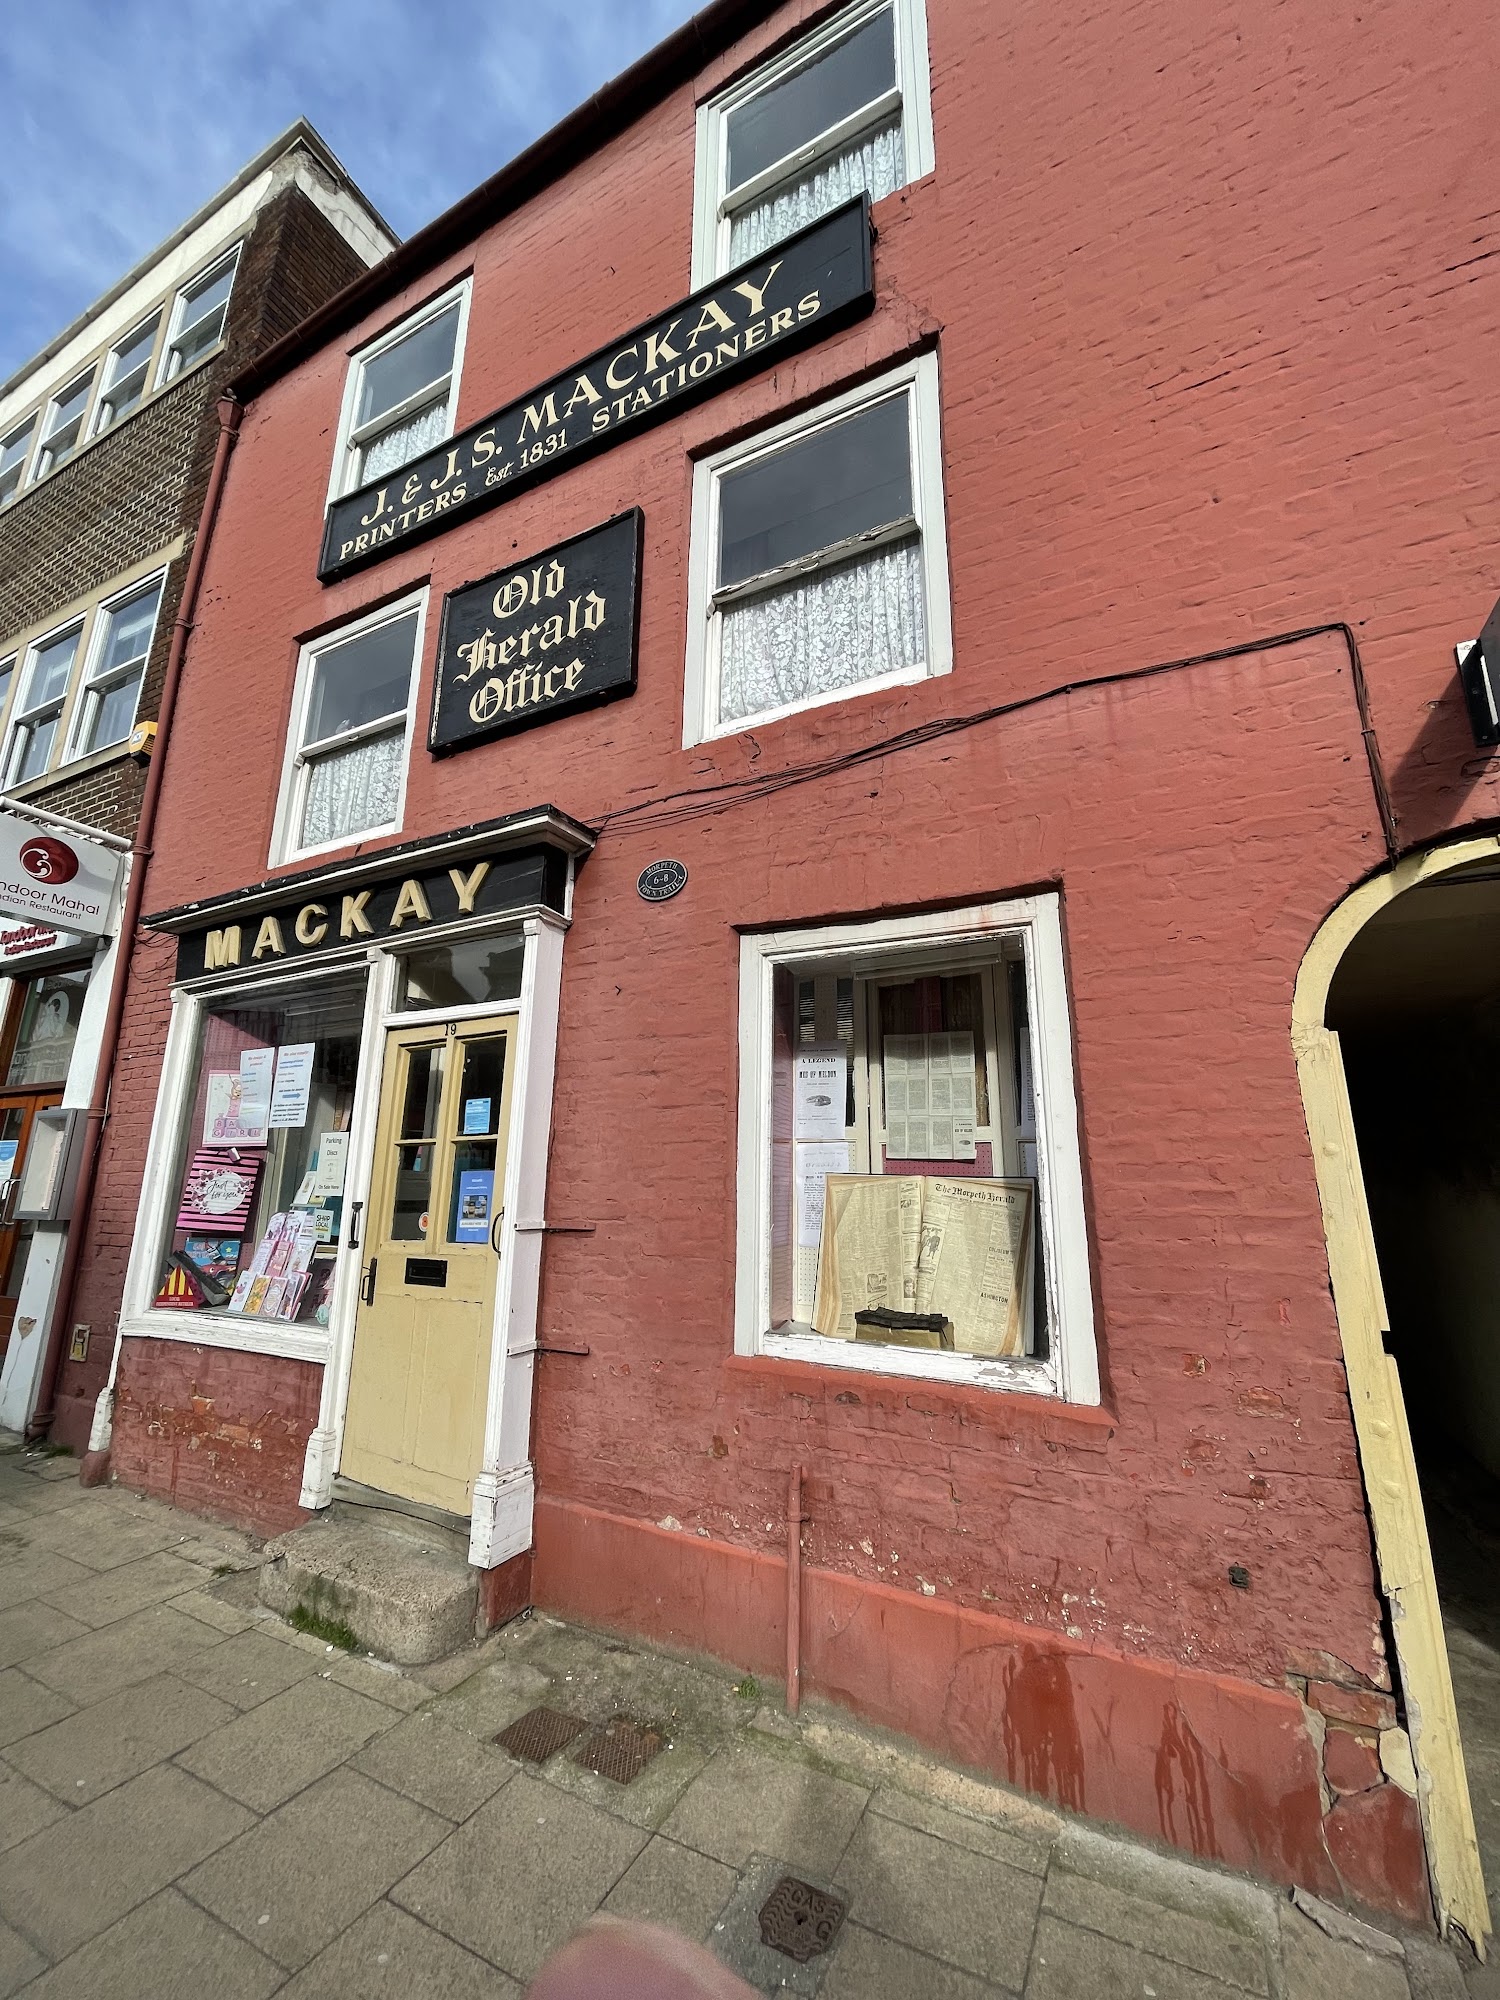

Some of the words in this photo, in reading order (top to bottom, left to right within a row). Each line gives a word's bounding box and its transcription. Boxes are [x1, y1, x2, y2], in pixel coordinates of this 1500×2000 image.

[402, 474, 422, 507] &
[517, 259, 783, 444] MACKAY
[339, 482, 467, 561] PRINTERS
[484, 460, 514, 487] Est.
[520, 428, 568, 469] 1831
[591, 289, 822, 433] STATIONERS
[492, 558, 566, 620] Old
[454, 591, 606, 683] Herald
[469, 657, 585, 724] Office
[645, 861, 678, 875] MORPETH
[29, 900, 82, 920] Restaurant
[51, 893, 100, 916] Mahal
[203, 862, 490, 971] MACKAY
[444, 1023, 457, 1037] 19
[326, 1137, 342, 1145] Parking
[935, 1183, 952, 1193] The
[952, 1186, 987, 1201] Morpeth
[987, 1191, 1016, 1204] Herald
[791, 1890, 827, 1913] GAS
